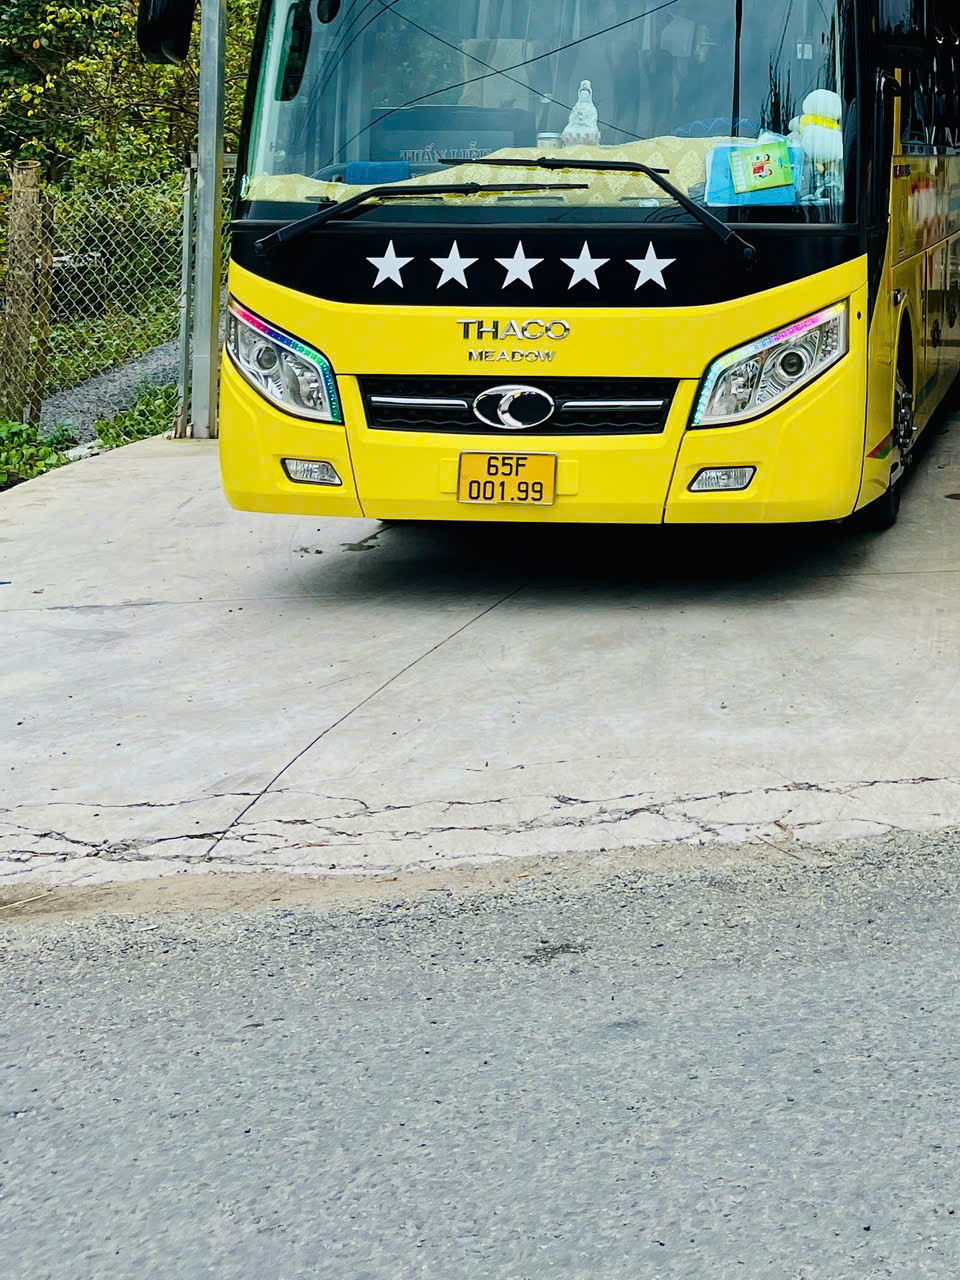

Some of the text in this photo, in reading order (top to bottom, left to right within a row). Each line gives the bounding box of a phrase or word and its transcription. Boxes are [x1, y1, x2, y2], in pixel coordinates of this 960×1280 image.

[456, 319, 570, 340] THACO
[468, 350, 556, 362] MEADOW
[487, 456, 528, 477] 65F
[469, 480, 544, 501] 001.99
